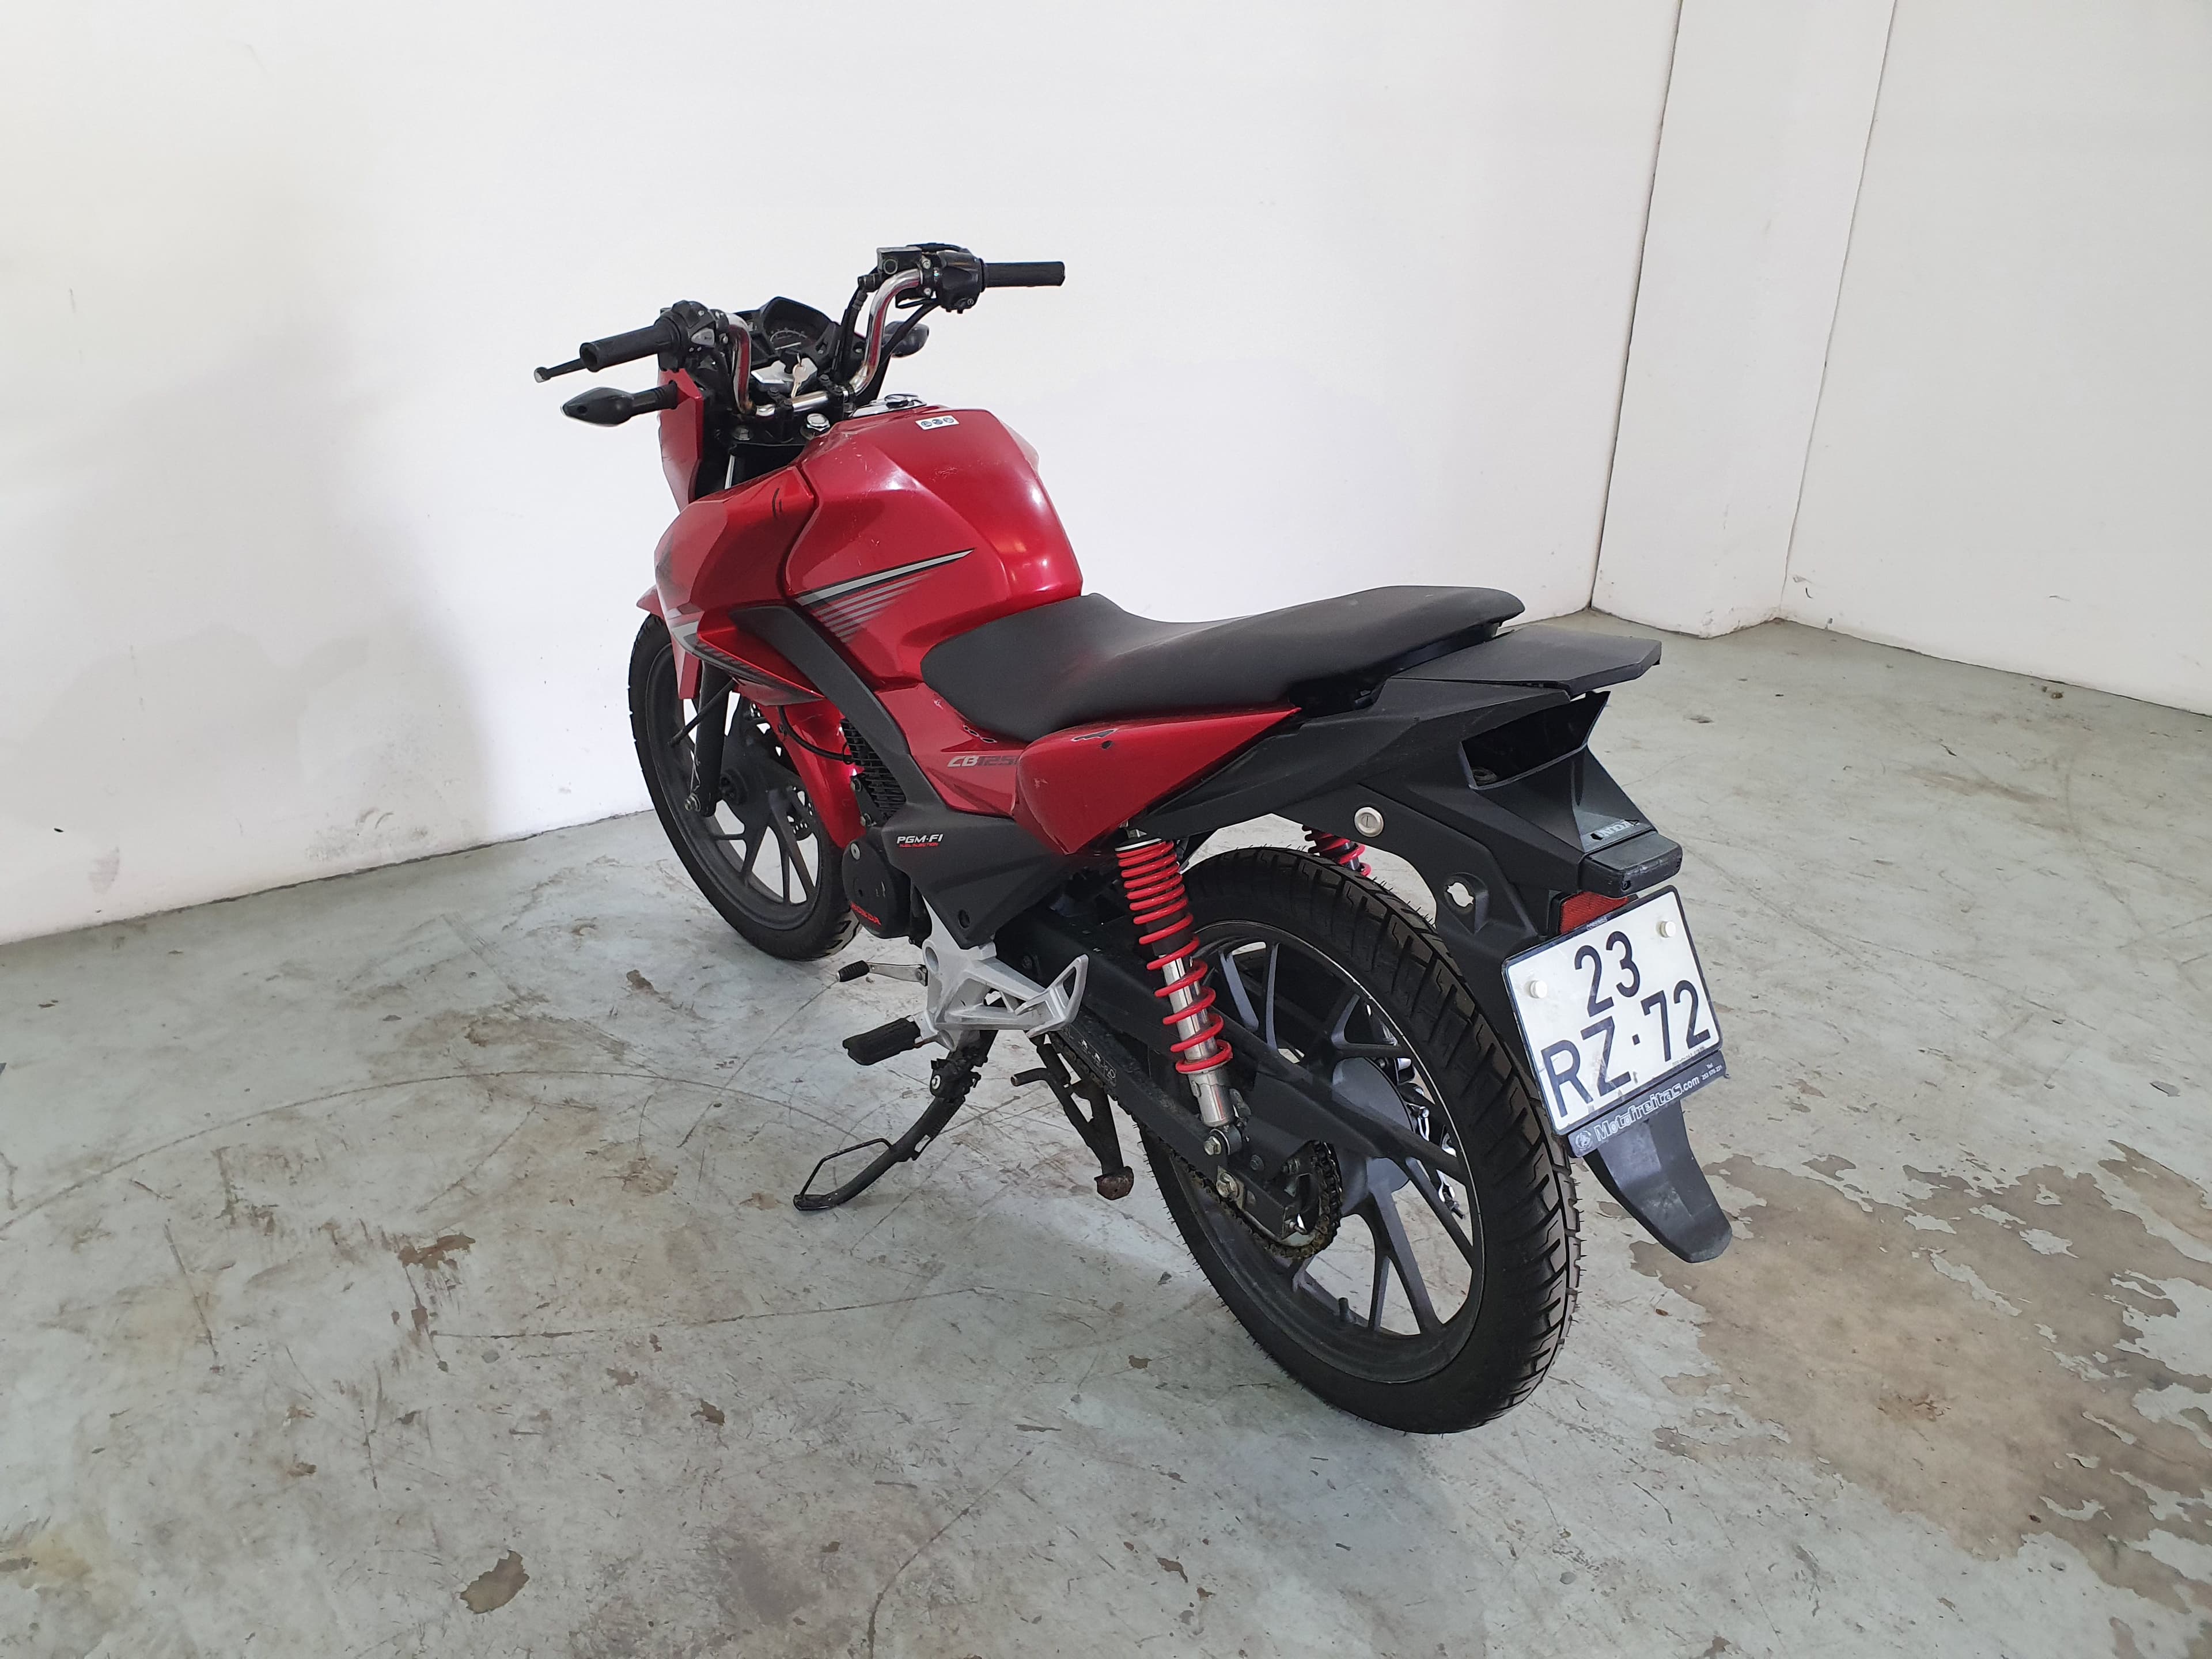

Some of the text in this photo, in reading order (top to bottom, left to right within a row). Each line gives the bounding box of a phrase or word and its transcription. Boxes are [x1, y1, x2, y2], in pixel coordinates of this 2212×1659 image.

[946, 755, 1019, 767] CB125
[1574, 931, 1641, 1018] 23
[1593, 1076, 1700, 1142] Motofreitas.com
